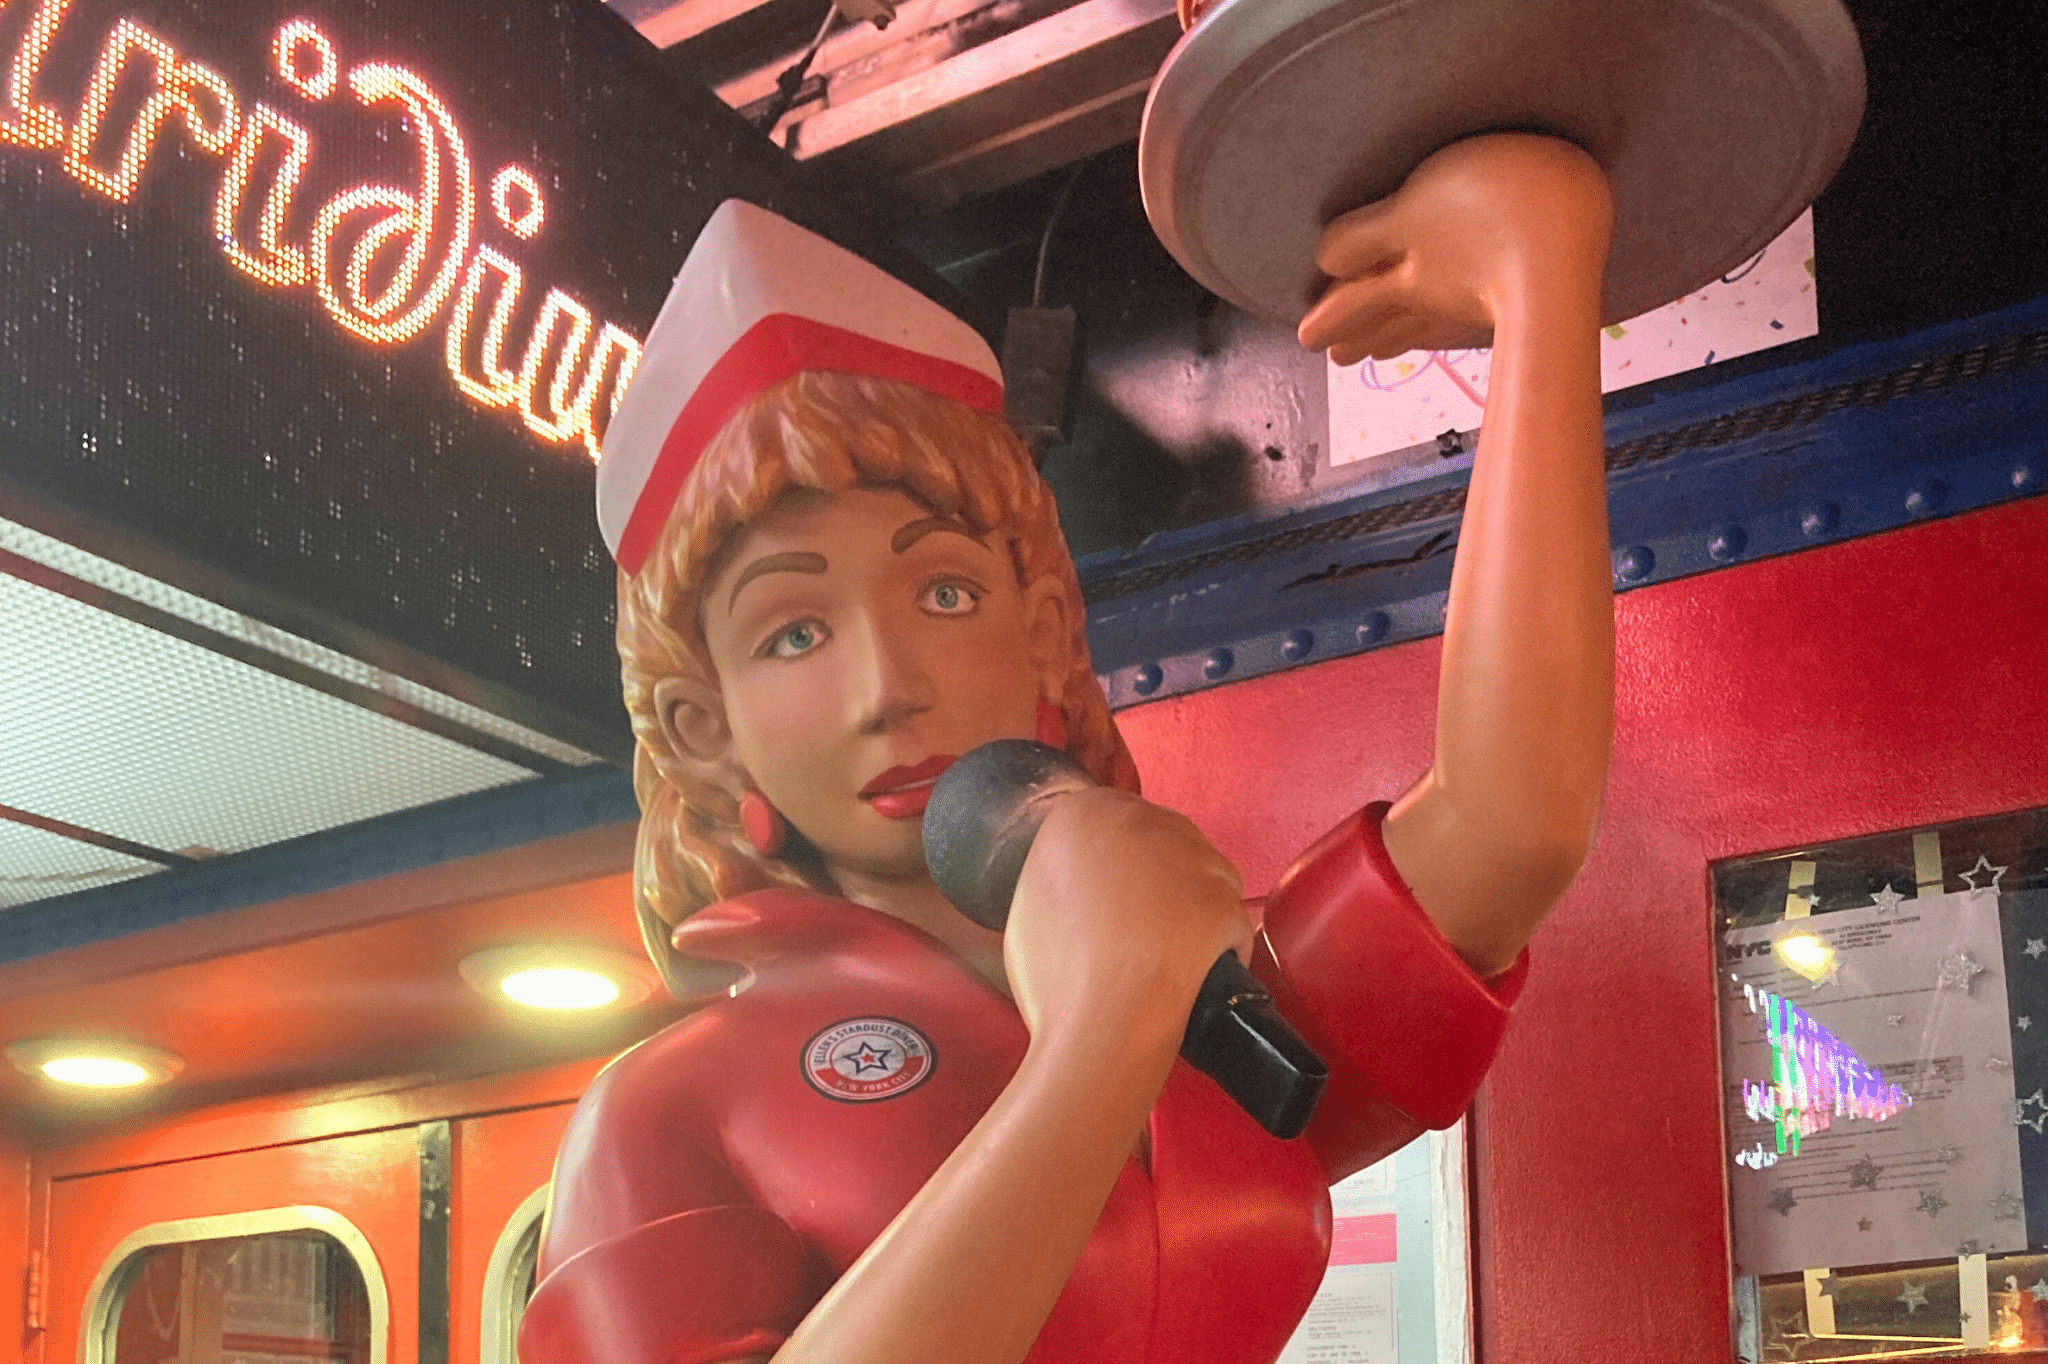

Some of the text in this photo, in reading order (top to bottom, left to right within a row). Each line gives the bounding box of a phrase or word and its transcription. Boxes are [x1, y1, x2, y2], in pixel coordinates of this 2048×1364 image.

[1855, 920, 1891, 930] LICENSING
[1893, 916, 1920, 925] CENTER
[1726, 940, 1771, 960] NYC
[835, 1024, 891, 1037] STARDUST
[891, 1029, 919, 1050] DINER
[862, 1080, 890, 1092] YORK
